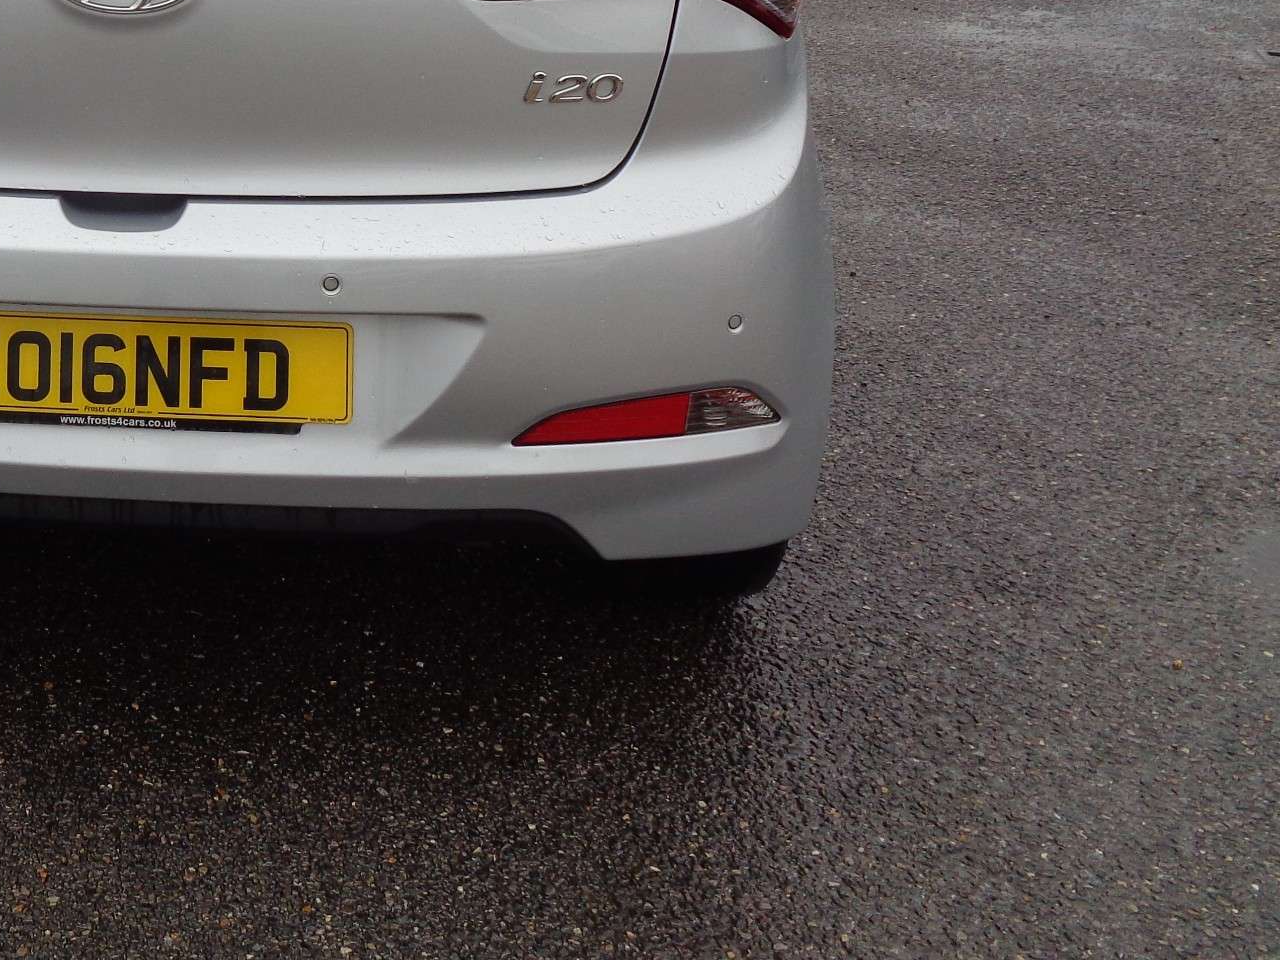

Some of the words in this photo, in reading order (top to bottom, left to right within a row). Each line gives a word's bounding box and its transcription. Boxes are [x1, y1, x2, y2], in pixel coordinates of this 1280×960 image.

[523, 71, 624, 103] i20
[84, 405, 105, 413] Frosts
[60, 415, 176, 428] www.frosts4cars.co.uk
